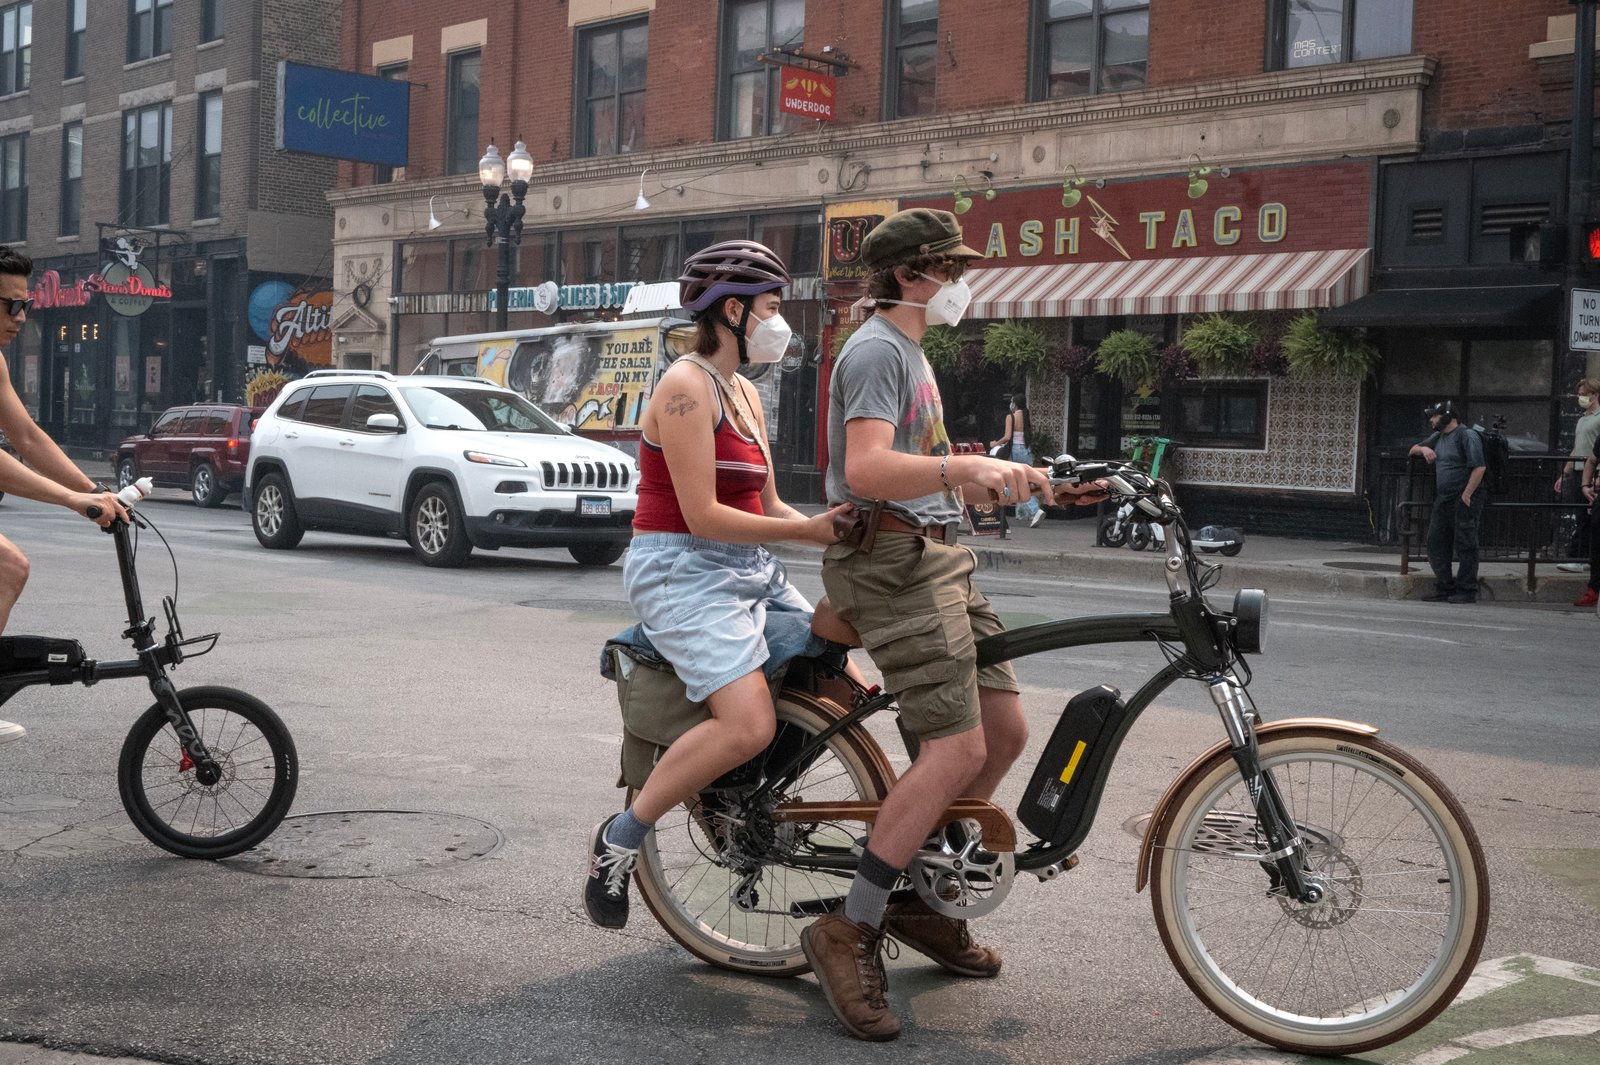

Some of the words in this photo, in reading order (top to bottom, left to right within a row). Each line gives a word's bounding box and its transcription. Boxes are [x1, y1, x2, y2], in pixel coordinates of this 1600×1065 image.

[297, 92, 390, 135] collective
[785, 97, 831, 116] UNDERDOG
[985, 217, 1079, 258] ASH
[1139, 202, 1288, 250] TACO
[127, 276, 172, 298] Donuts
[488, 289, 535, 309] PZERIA
[558, 286, 597, 308] SLICES
[1583, 298, 1596, 310] NO
[838, 306, 851, 314] HO
[1579, 314, 1600, 327] TURN
[1590, 332, 1600, 344] RE
[606, 343, 629, 355] YOU
[630, 339, 652, 354] ARE
[620, 356, 652, 369] SALSA
[615, 371, 630, 383] ON
[632, 371, 649, 383] MY
